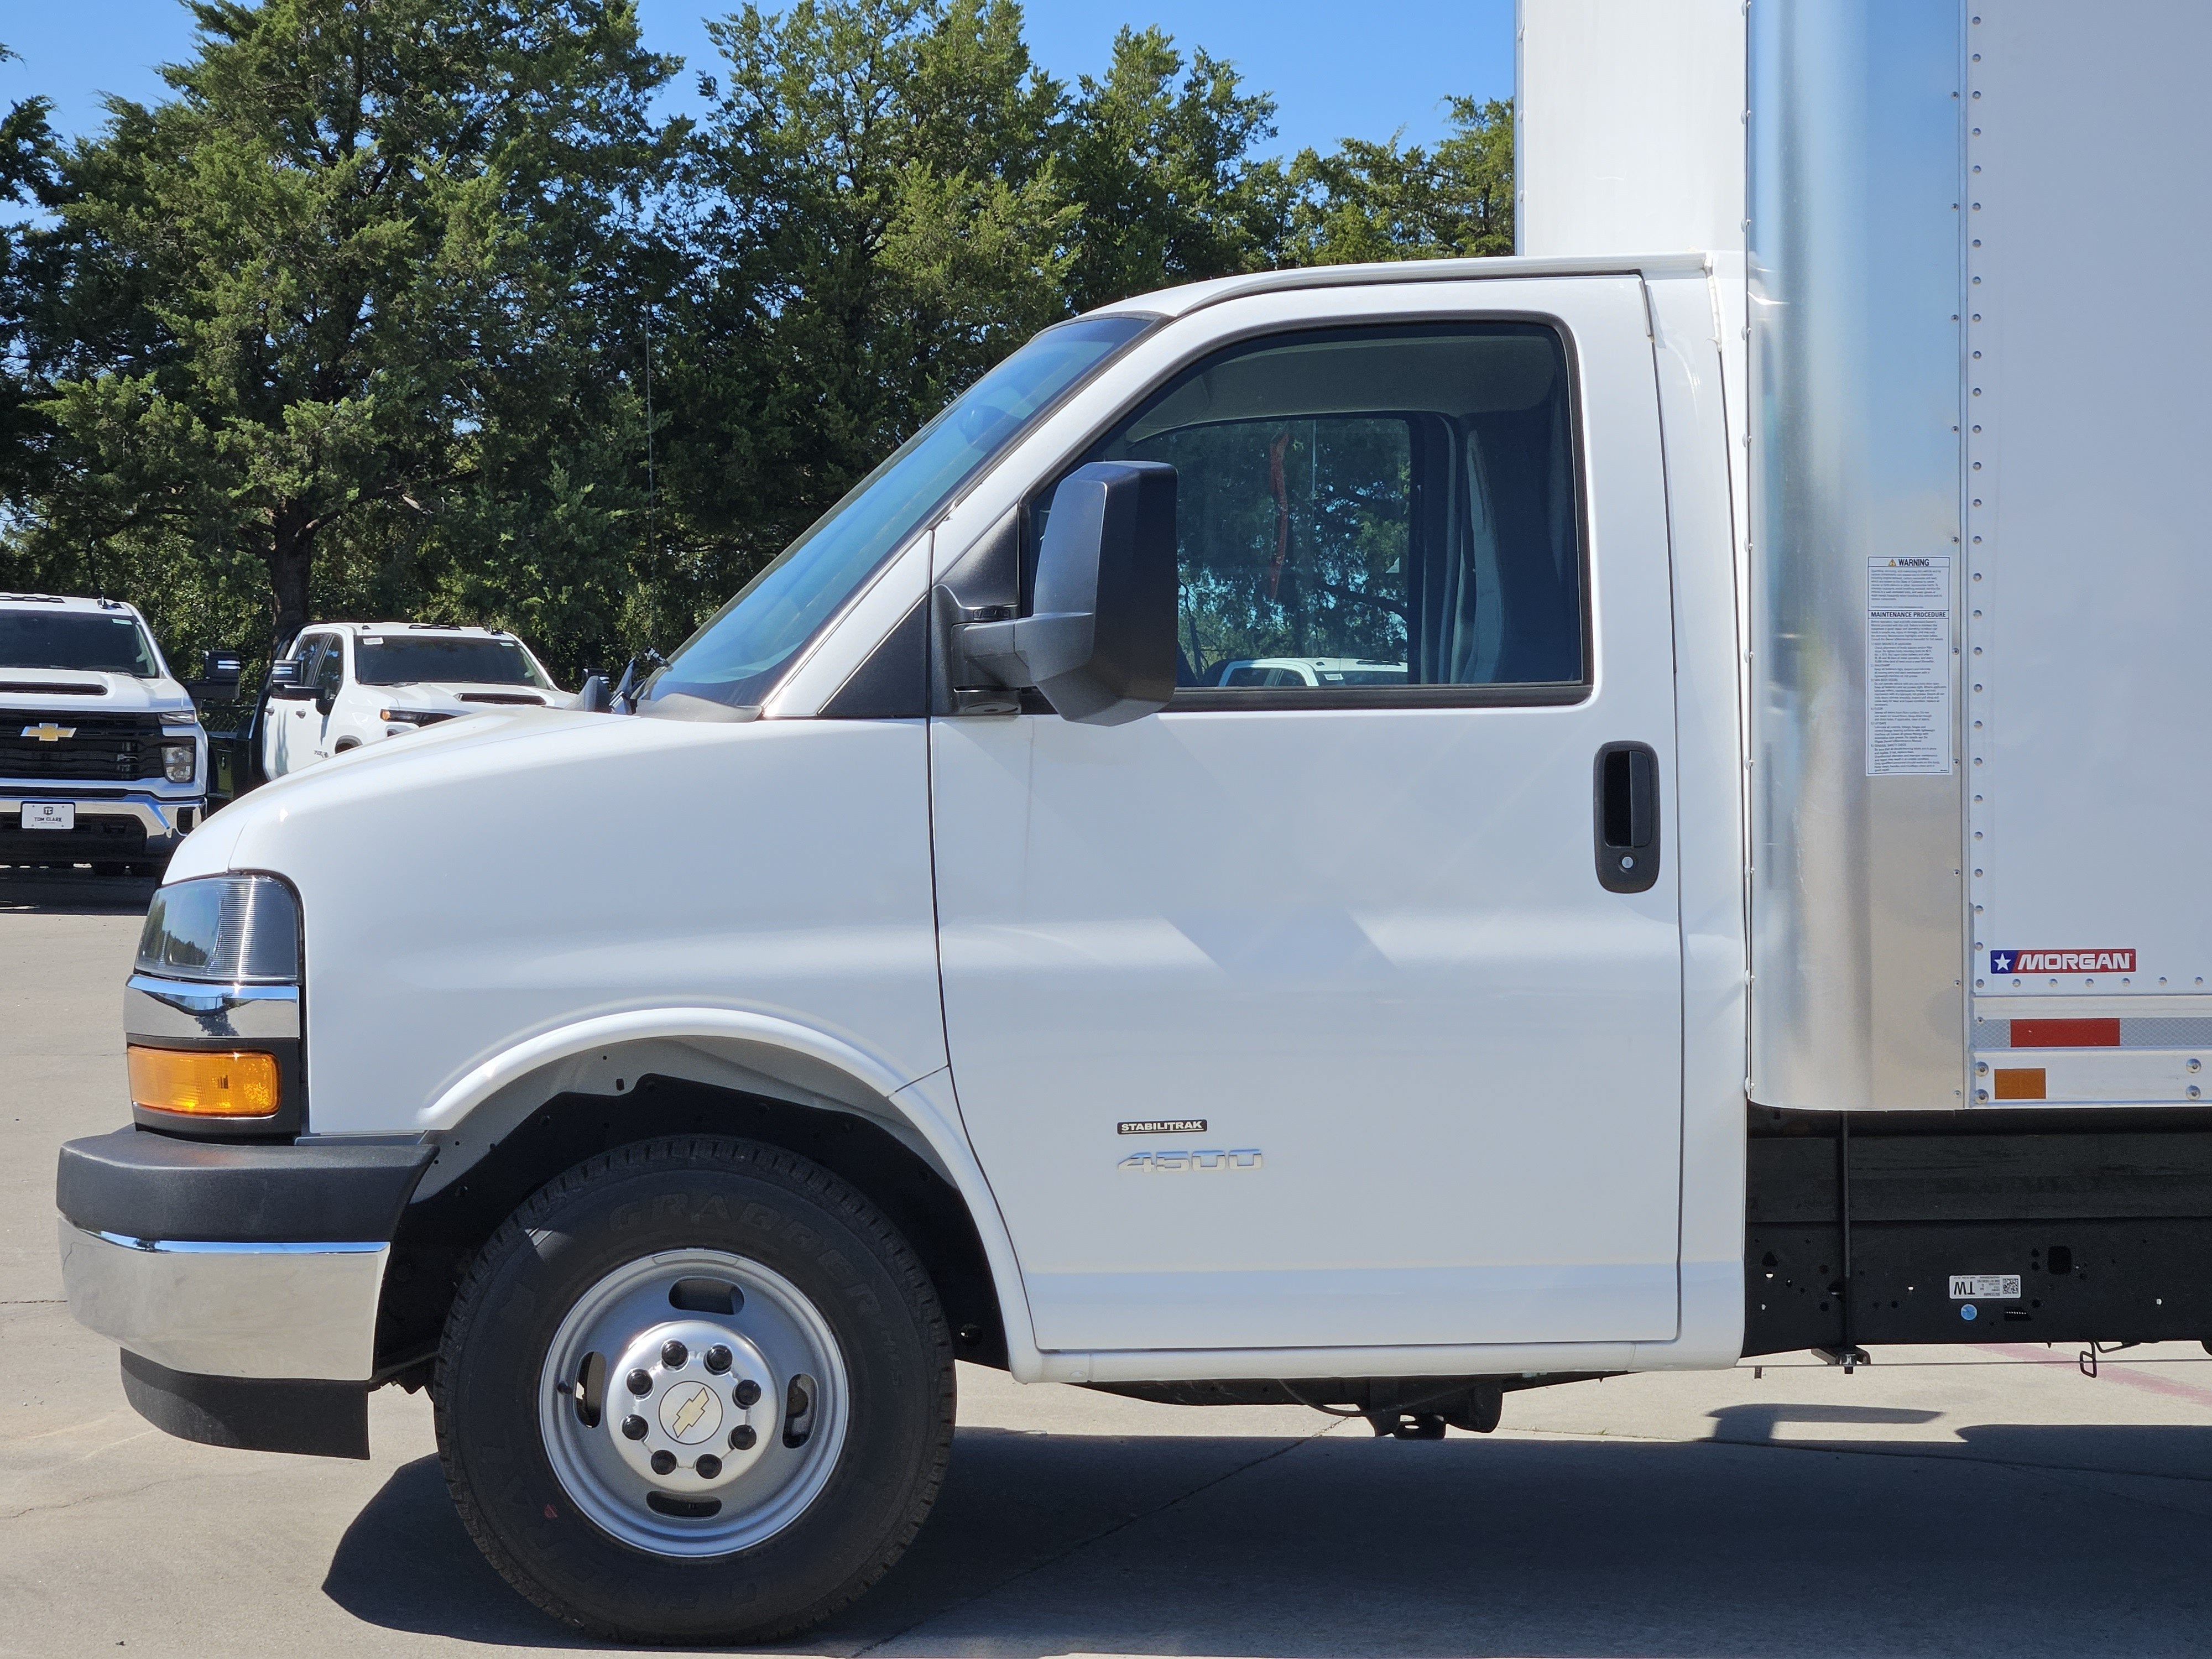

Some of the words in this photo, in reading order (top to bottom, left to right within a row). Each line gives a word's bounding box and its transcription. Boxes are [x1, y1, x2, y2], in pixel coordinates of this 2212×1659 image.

[2017, 953, 2130, 970] MORGAN
[1121, 1120, 1202, 1131] STABILITRAK
[1118, 1149, 1262, 1173] 4500
[609, 1193, 883, 1318] GRABBER
[1954, 1281, 1976, 1295] TW
